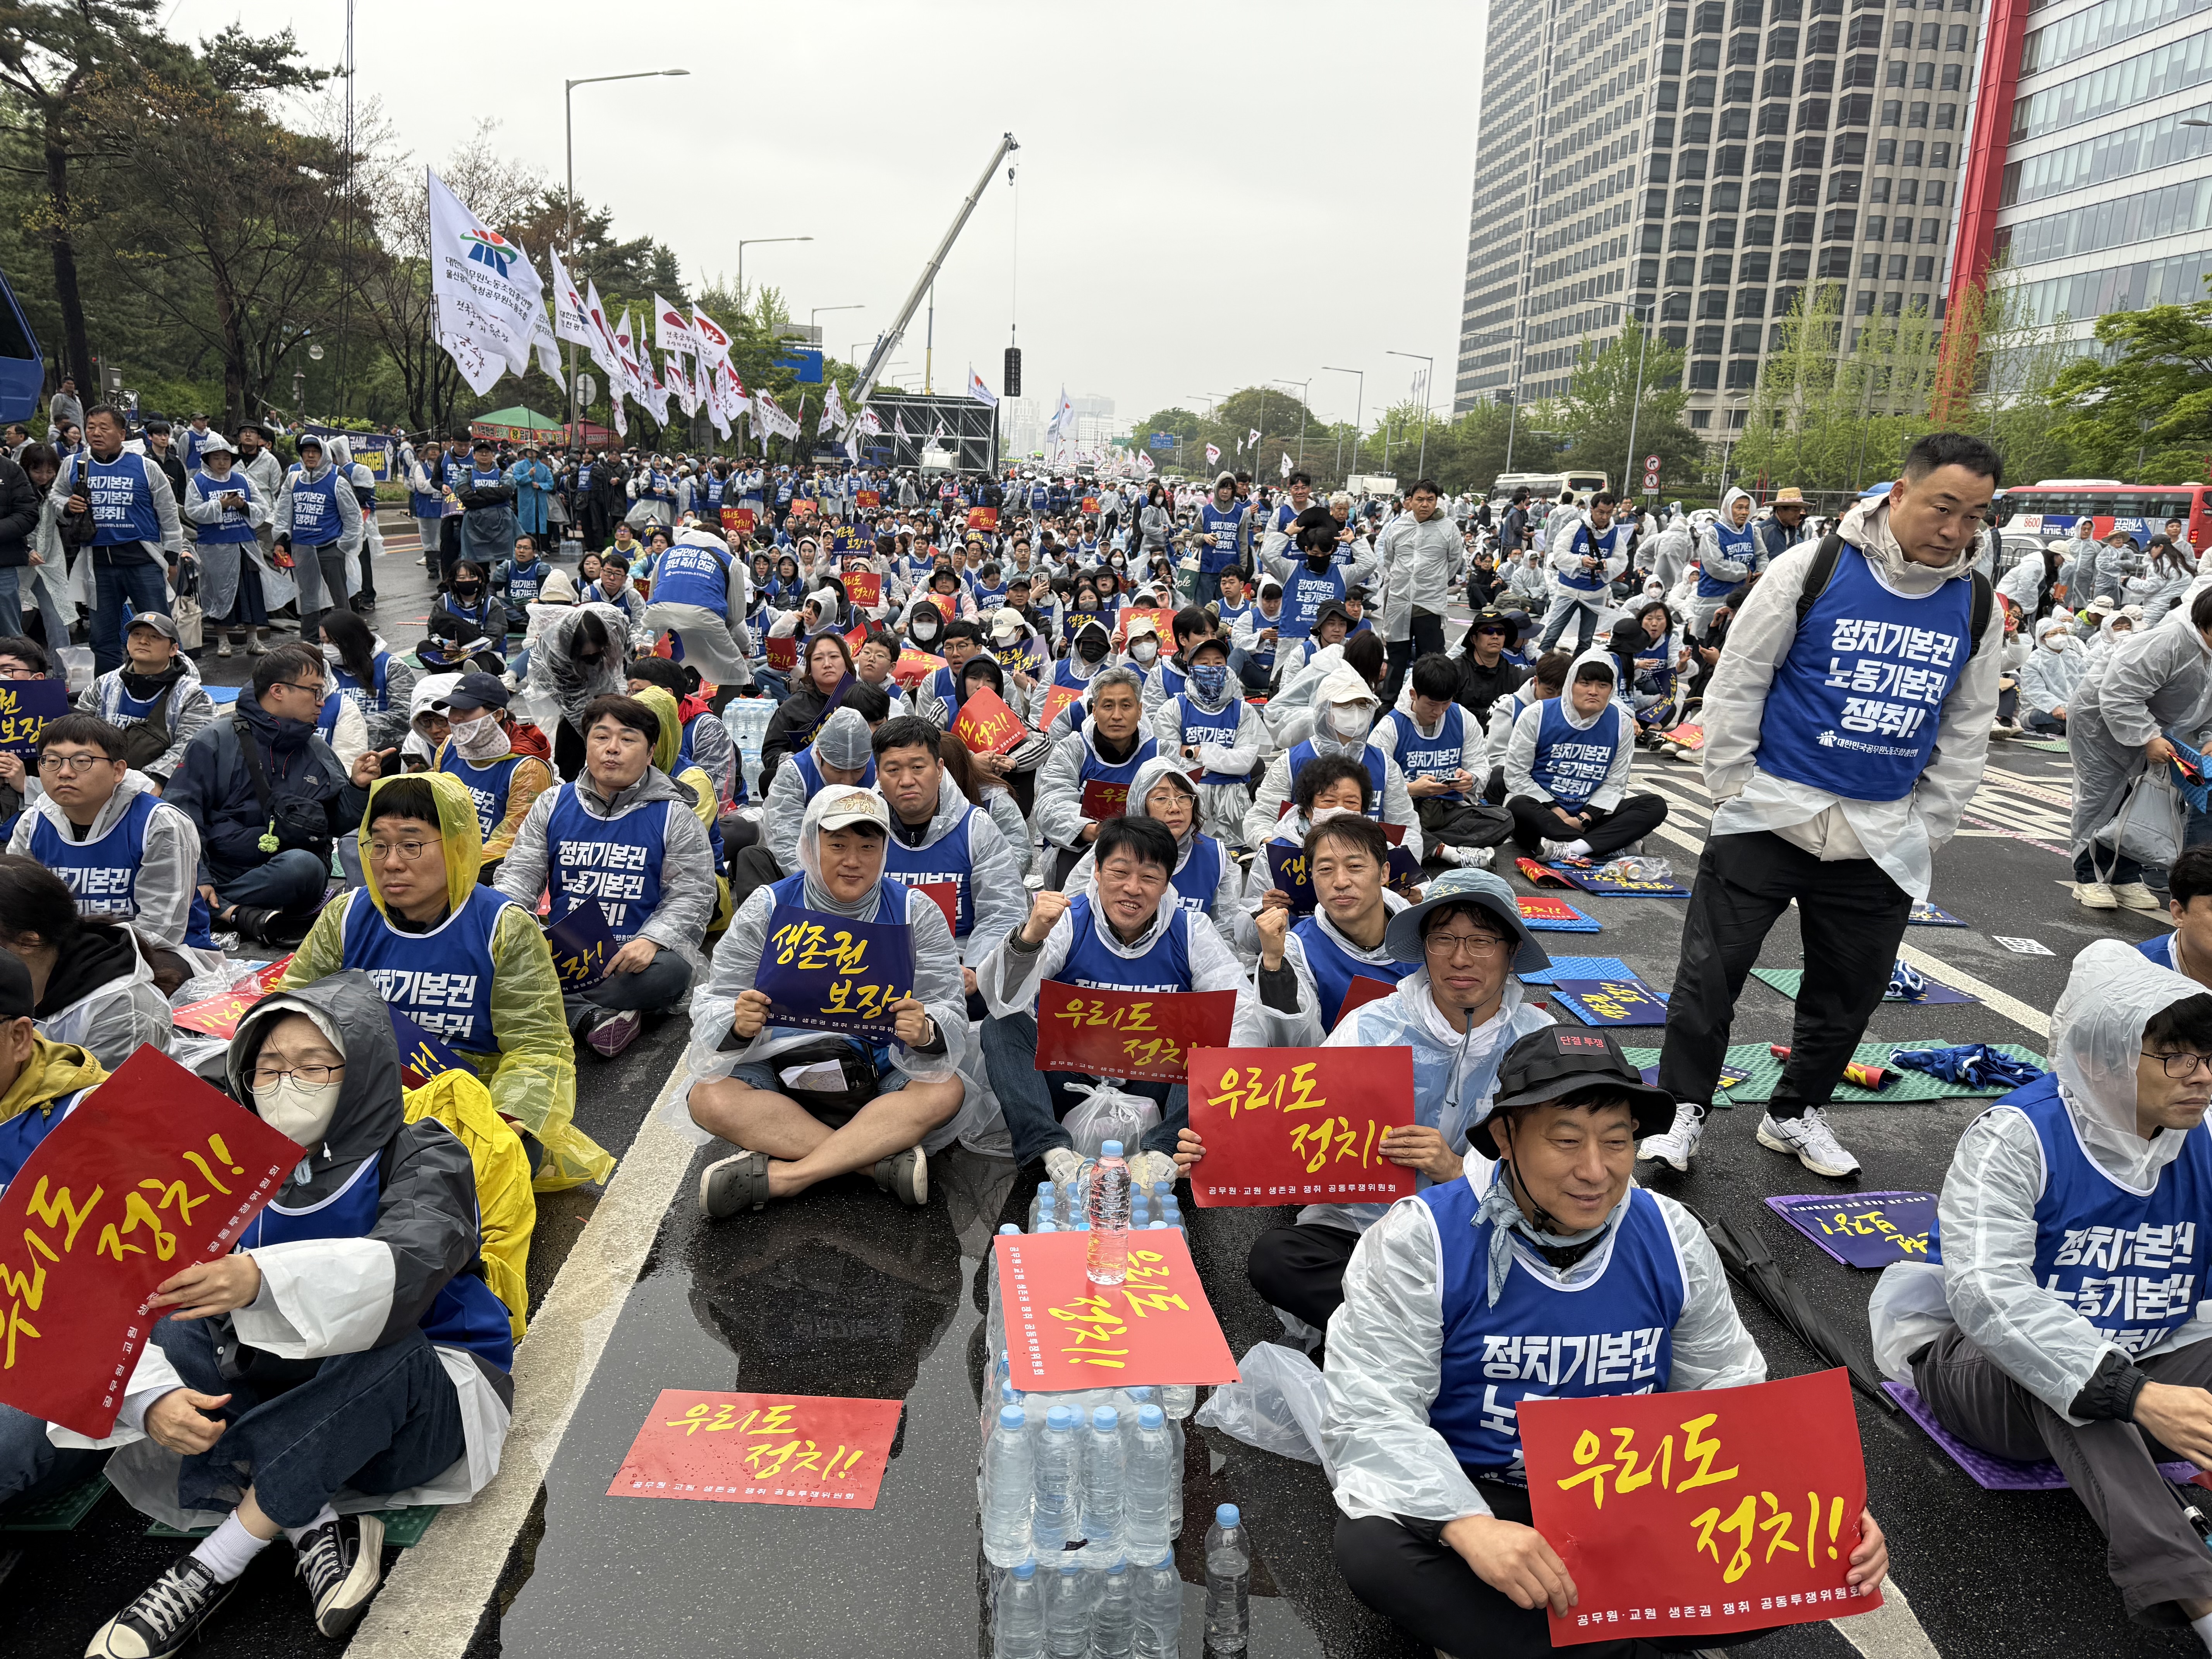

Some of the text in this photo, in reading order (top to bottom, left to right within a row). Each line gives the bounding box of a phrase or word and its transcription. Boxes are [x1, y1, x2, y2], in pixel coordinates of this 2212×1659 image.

[87, 476, 134, 490] 치기본권
[91, 491, 133, 505] 동기본권
[91, 506, 125, 520] 쟁취!
[722, 510, 740, 520] 우리도
[970, 509, 986, 517] 우리도
[2024, 517, 2040, 527] 8600
[733, 519, 750, 529] 정치!
[835, 525, 857, 539] 생존권
[2114, 518, 2143, 532] 공공버스
[668, 548, 701, 560] 임금인상
[846, 538, 868, 550] 보장!
[665, 557, 716, 574] 정년 즉시 연금!
[843, 574, 862, 586] 우리도
[1298, 579, 1335, 593] 정치기본권
[853, 587, 876, 601] 정치!
[1831, 618, 1959, 668] 정치기본권
[899, 652, 935, 663] 우리도
[1824, 657, 1947, 706] 노동기본권
[1841, 697, 1927, 738] 쟁취!
[975, 712, 1011, 747] 정치!
[1186, 726, 1236, 744] 정치기본권
[1406, 747, 1461, 766] 정치기본권
[1550, 744, 1611, 763] 정치기본권
[1837, 738, 1919, 757] 대한민국공무원노동조합총연맹
[1550, 775, 1593, 795] 쟁취!
[558, 840, 648, 871] 정치기본권
[561, 870, 646, 900] 노동기본권
[771, 921, 869, 975] 생존권
[820, 978, 913, 1019] 보장
[1054, 998, 1158, 1031] 우리도
[1560, 1035, 1604, 1049] 단결 투쟁
[1122, 1037, 1189, 1070] 정치
[1207, 1062, 1327, 1120] 우리도
[1289, 1116, 1395, 1173] 정치!
[96, 1133, 246, 1261] 정치!
[1208, 1183, 1397, 1196] 공무원·교원 생존권 쟁취 공동투쟁위원회
[206, 1164, 281, 1253] 공동투쟁위원회
[2053, 1221, 2197, 1272] 정치기본권
[1048, 1294, 1130, 1369] 정치!
[1479, 1327, 1664, 1386] 정치기본권
[102, 1325, 139, 1409] 공무원·교원
[666, 1403, 799, 1437] 우리도
[744, 1439, 864, 1480] 정치!
[1557, 1413, 1740, 1510] 우리도
[632, 1480, 855, 1500] 공무원·교원 생존권 쟁취 공동투쟁위원회
[1690, 1491, 1845, 1584] 정치!
[1576, 1585, 1862, 1626] 공무원·교원 생존권 쟁취 공동투쟁위원회
